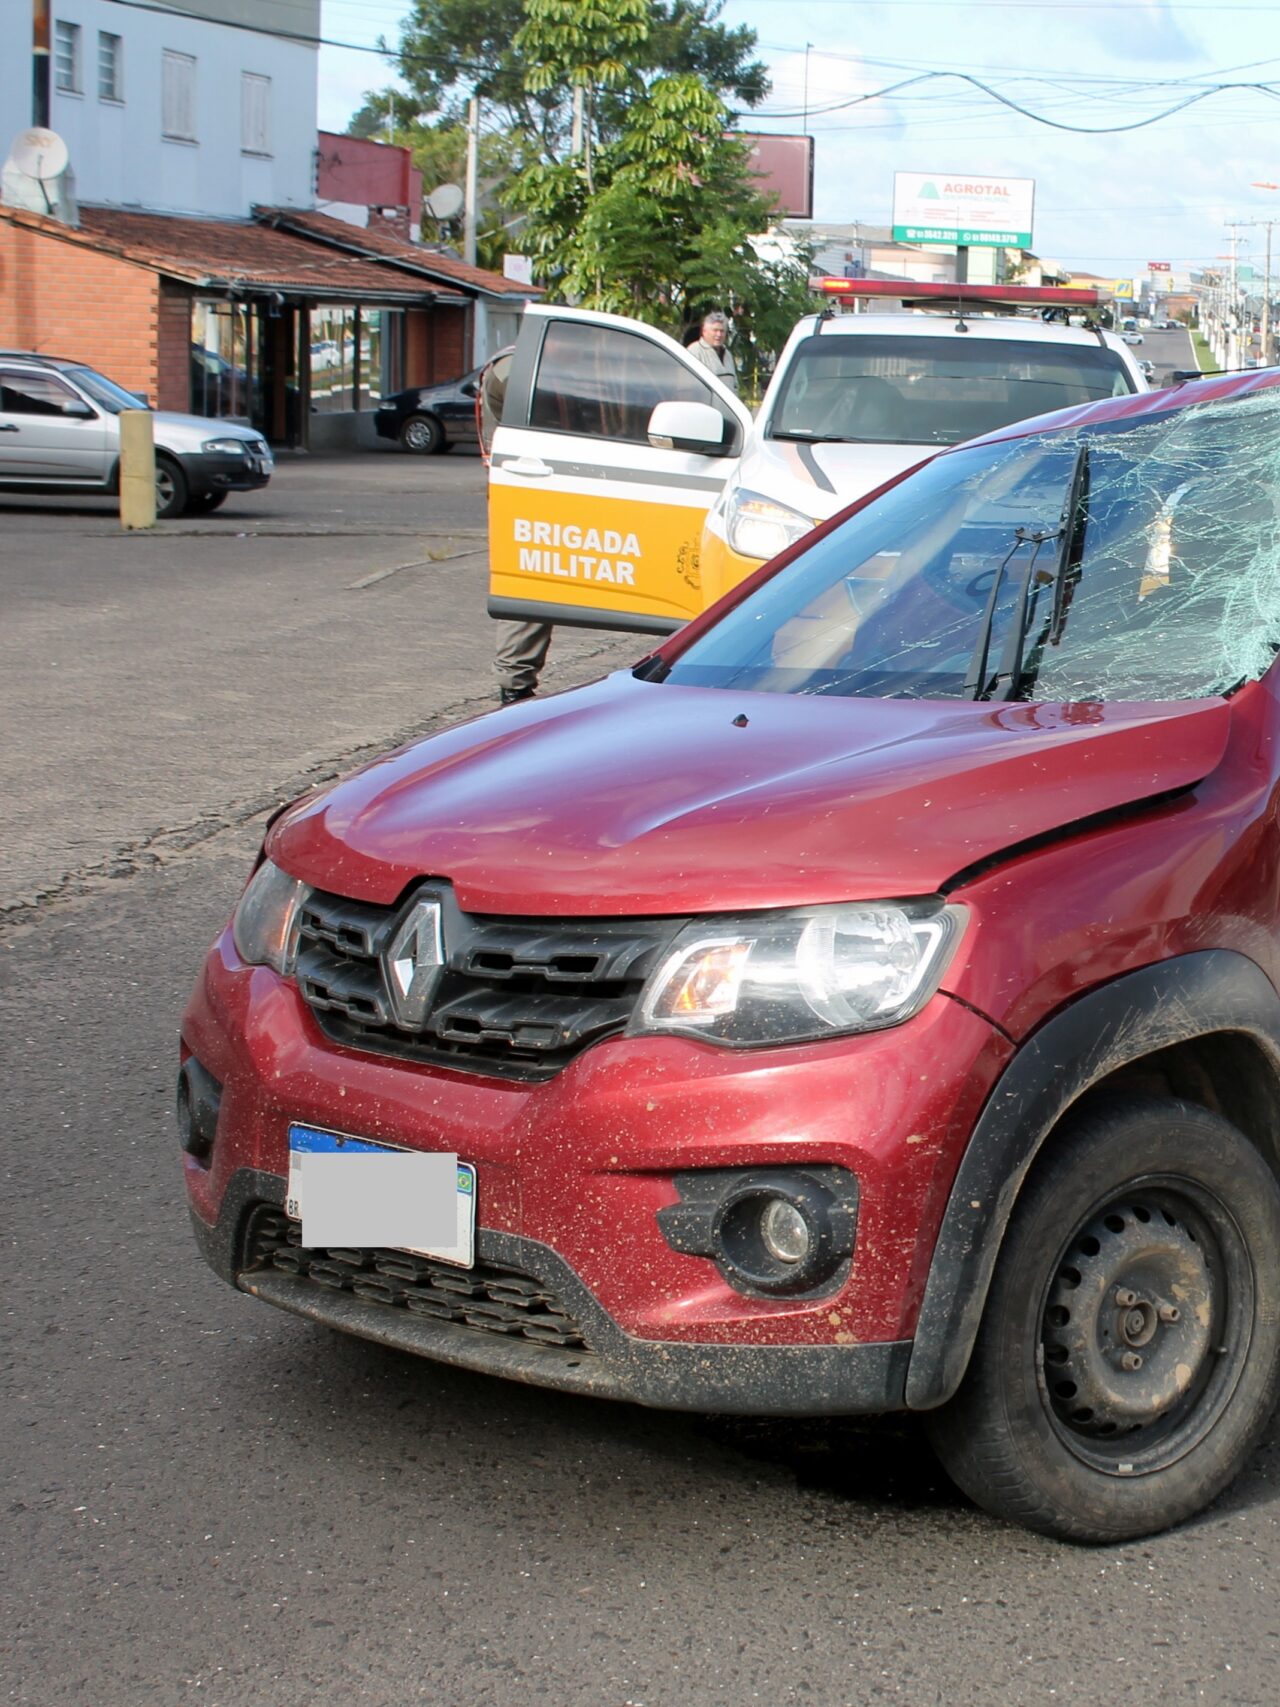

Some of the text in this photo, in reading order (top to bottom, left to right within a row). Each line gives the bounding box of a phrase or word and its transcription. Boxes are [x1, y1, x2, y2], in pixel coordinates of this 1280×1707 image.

[943, 183, 1010, 196] AGROTAL
[514, 518, 642, 557] BRIGADA
[519, 548, 636, 585] MILITAR
[288, 1199, 299, 1216] BR
